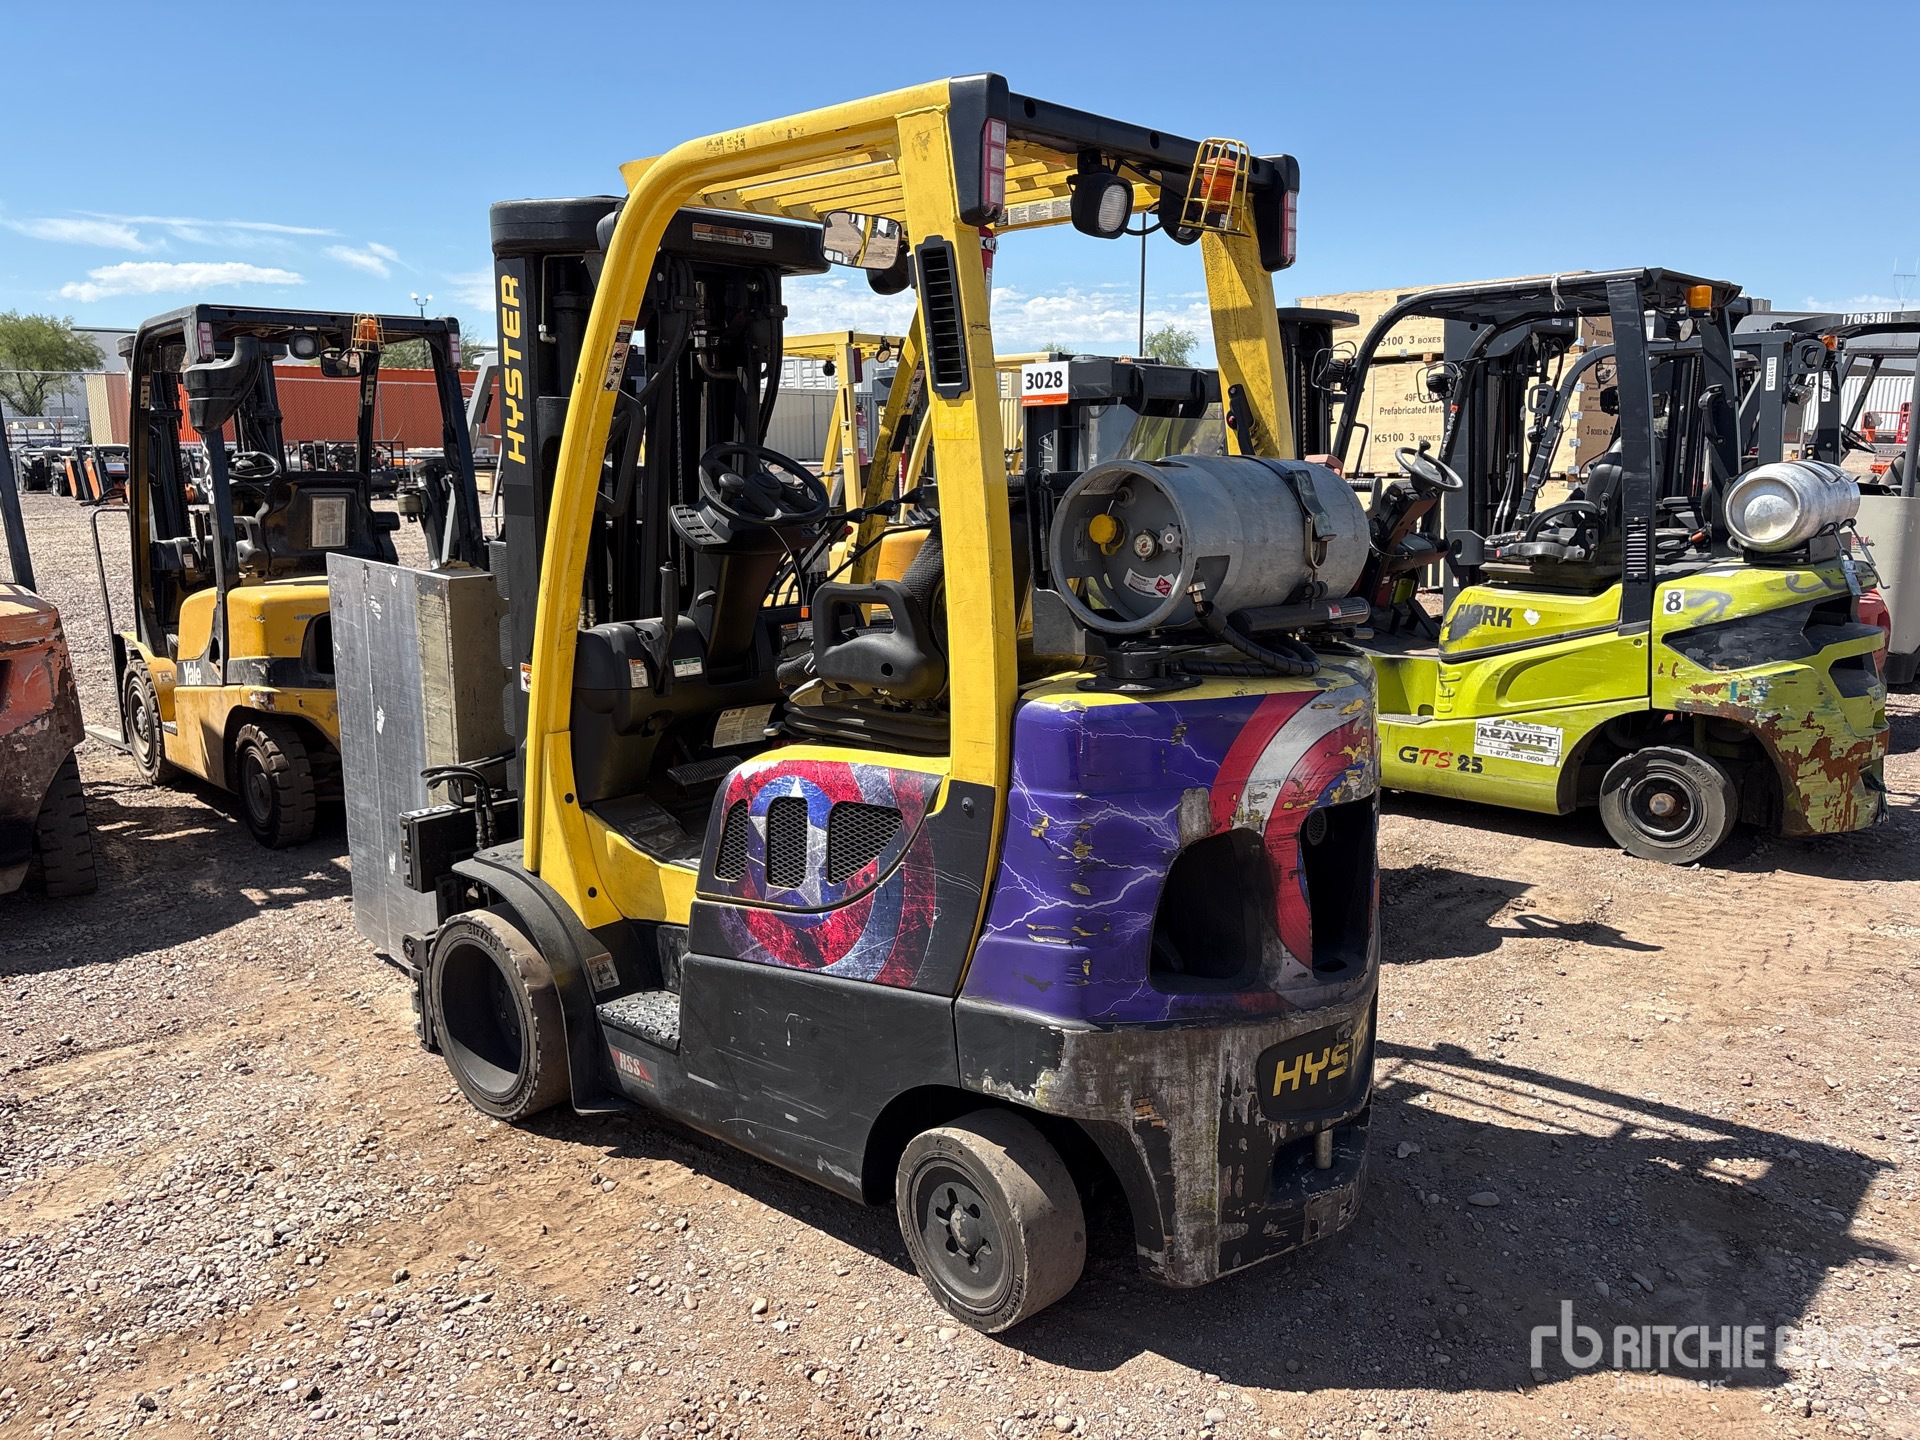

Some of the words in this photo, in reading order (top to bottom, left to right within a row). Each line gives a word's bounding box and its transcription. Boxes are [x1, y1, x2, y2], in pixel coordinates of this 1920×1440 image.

[1842, 312, 1892, 325] 17063811
[1378, 336, 1404, 347] 5100
[1409, 335, 1415, 345] 3
[1417, 336, 1441, 344] BOXES
[500, 274, 528, 466] HYSTER
[1025, 370, 1064, 390] 3028
[1379, 405, 1427, 416] Prefabricated
[1374, 433, 1404, 443] K5100
[1409, 432, 1416, 441] 3
[1417, 434, 1441, 442] BOXES
[1665, 591, 1682, 613] 8
[182, 661, 202, 685] Yale
[1398, 746, 1454, 768] GTS
[1457, 754, 1483, 774] 25
[1489, 749, 1544, 763] 1-877-251-0604
[618, 1051, 641, 1076] HSS
